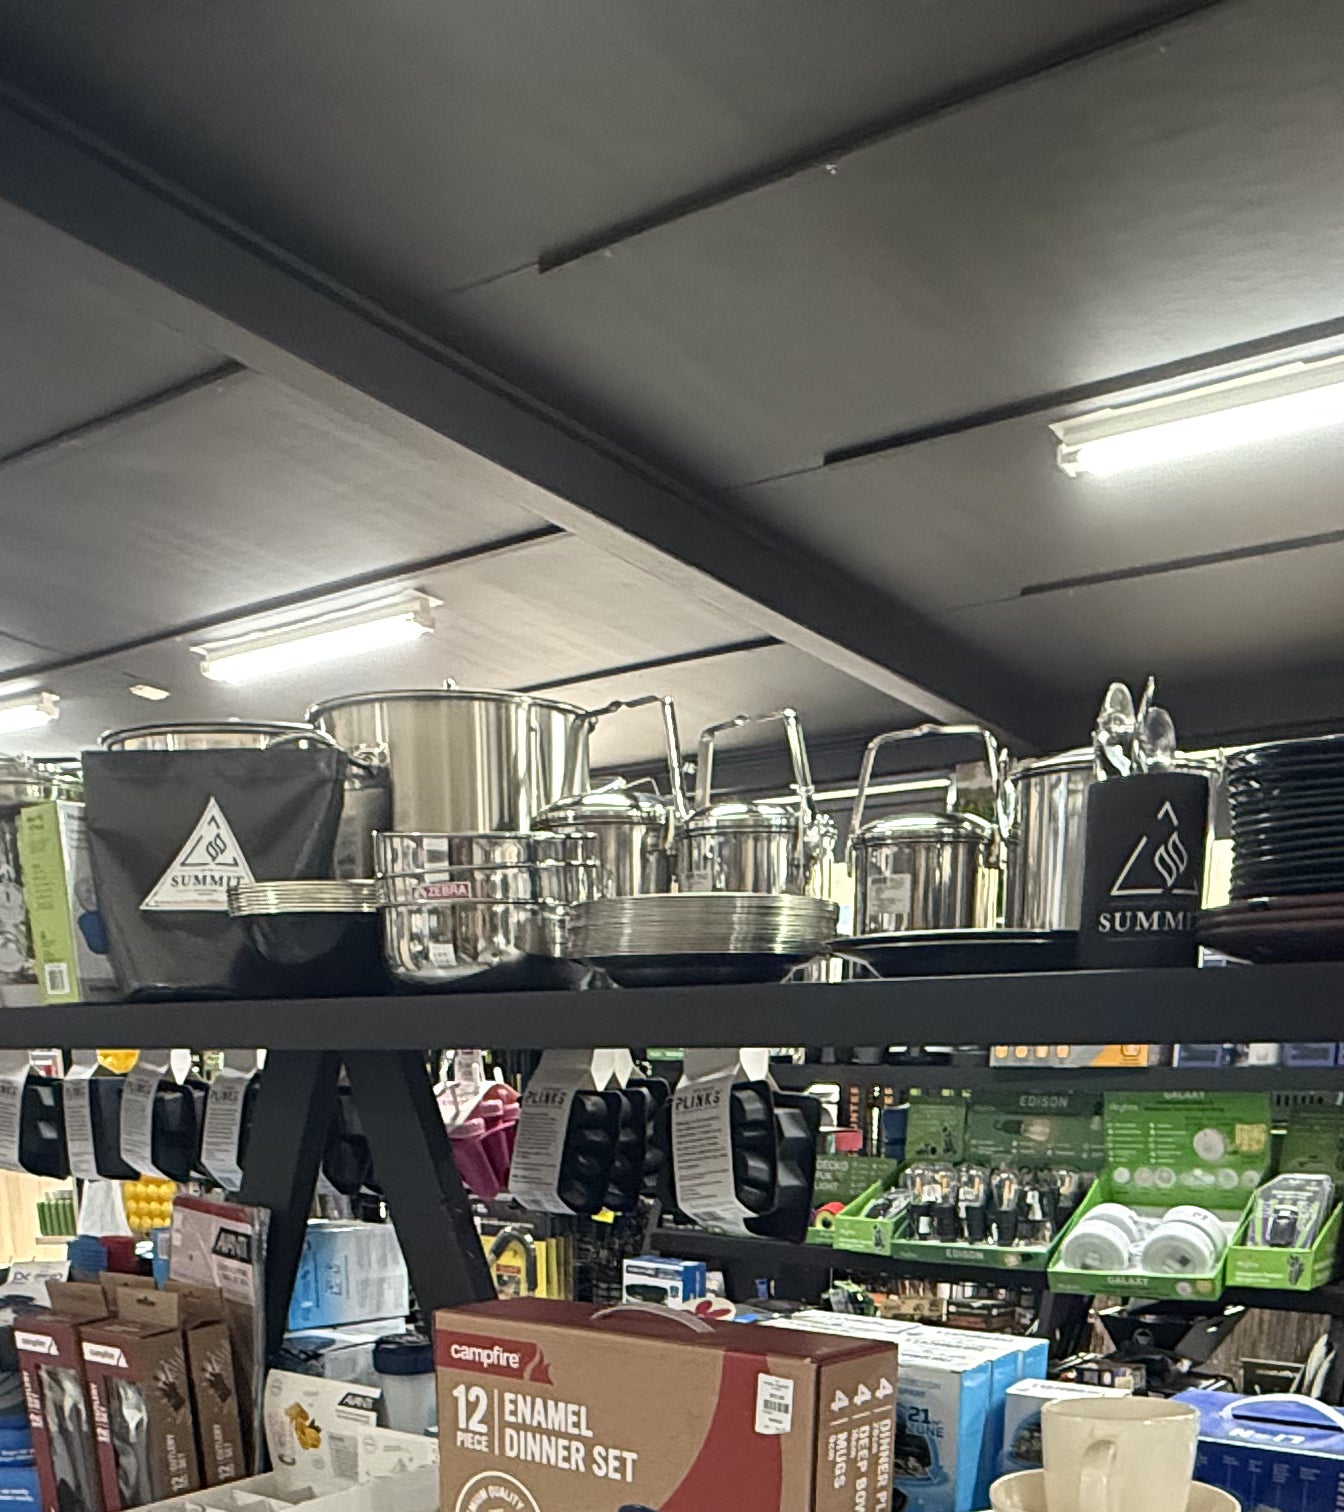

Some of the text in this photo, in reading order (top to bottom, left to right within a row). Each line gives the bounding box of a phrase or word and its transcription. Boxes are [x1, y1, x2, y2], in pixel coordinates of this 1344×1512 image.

[170, 875, 245, 889] SUMMIT
[428, 884, 468, 897] ZEBRA
[526, 1090, 567, 1106] PLINKS
[675, 1090, 721, 1111] PLINKS
[1019, 1094, 1069, 1107] EDISON
[450, 1344, 520, 1369] campfire
[853, 1383, 872, 1406] 4
[875, 1377, 893, 1400] 4
[453, 1384, 488, 1434] 12
[503, 1392, 594, 1438] ENAMEL
[908, 1406, 930, 1423] 21
[456, 1431, 489, 1452] PIECE
[830, 1389, 849, 1489] 4 MUGS
[856, 1424, 871, 1473] DEEP
[505, 1427, 638, 1483] DINNER SET
[875, 1418, 893, 1487] DINNER
